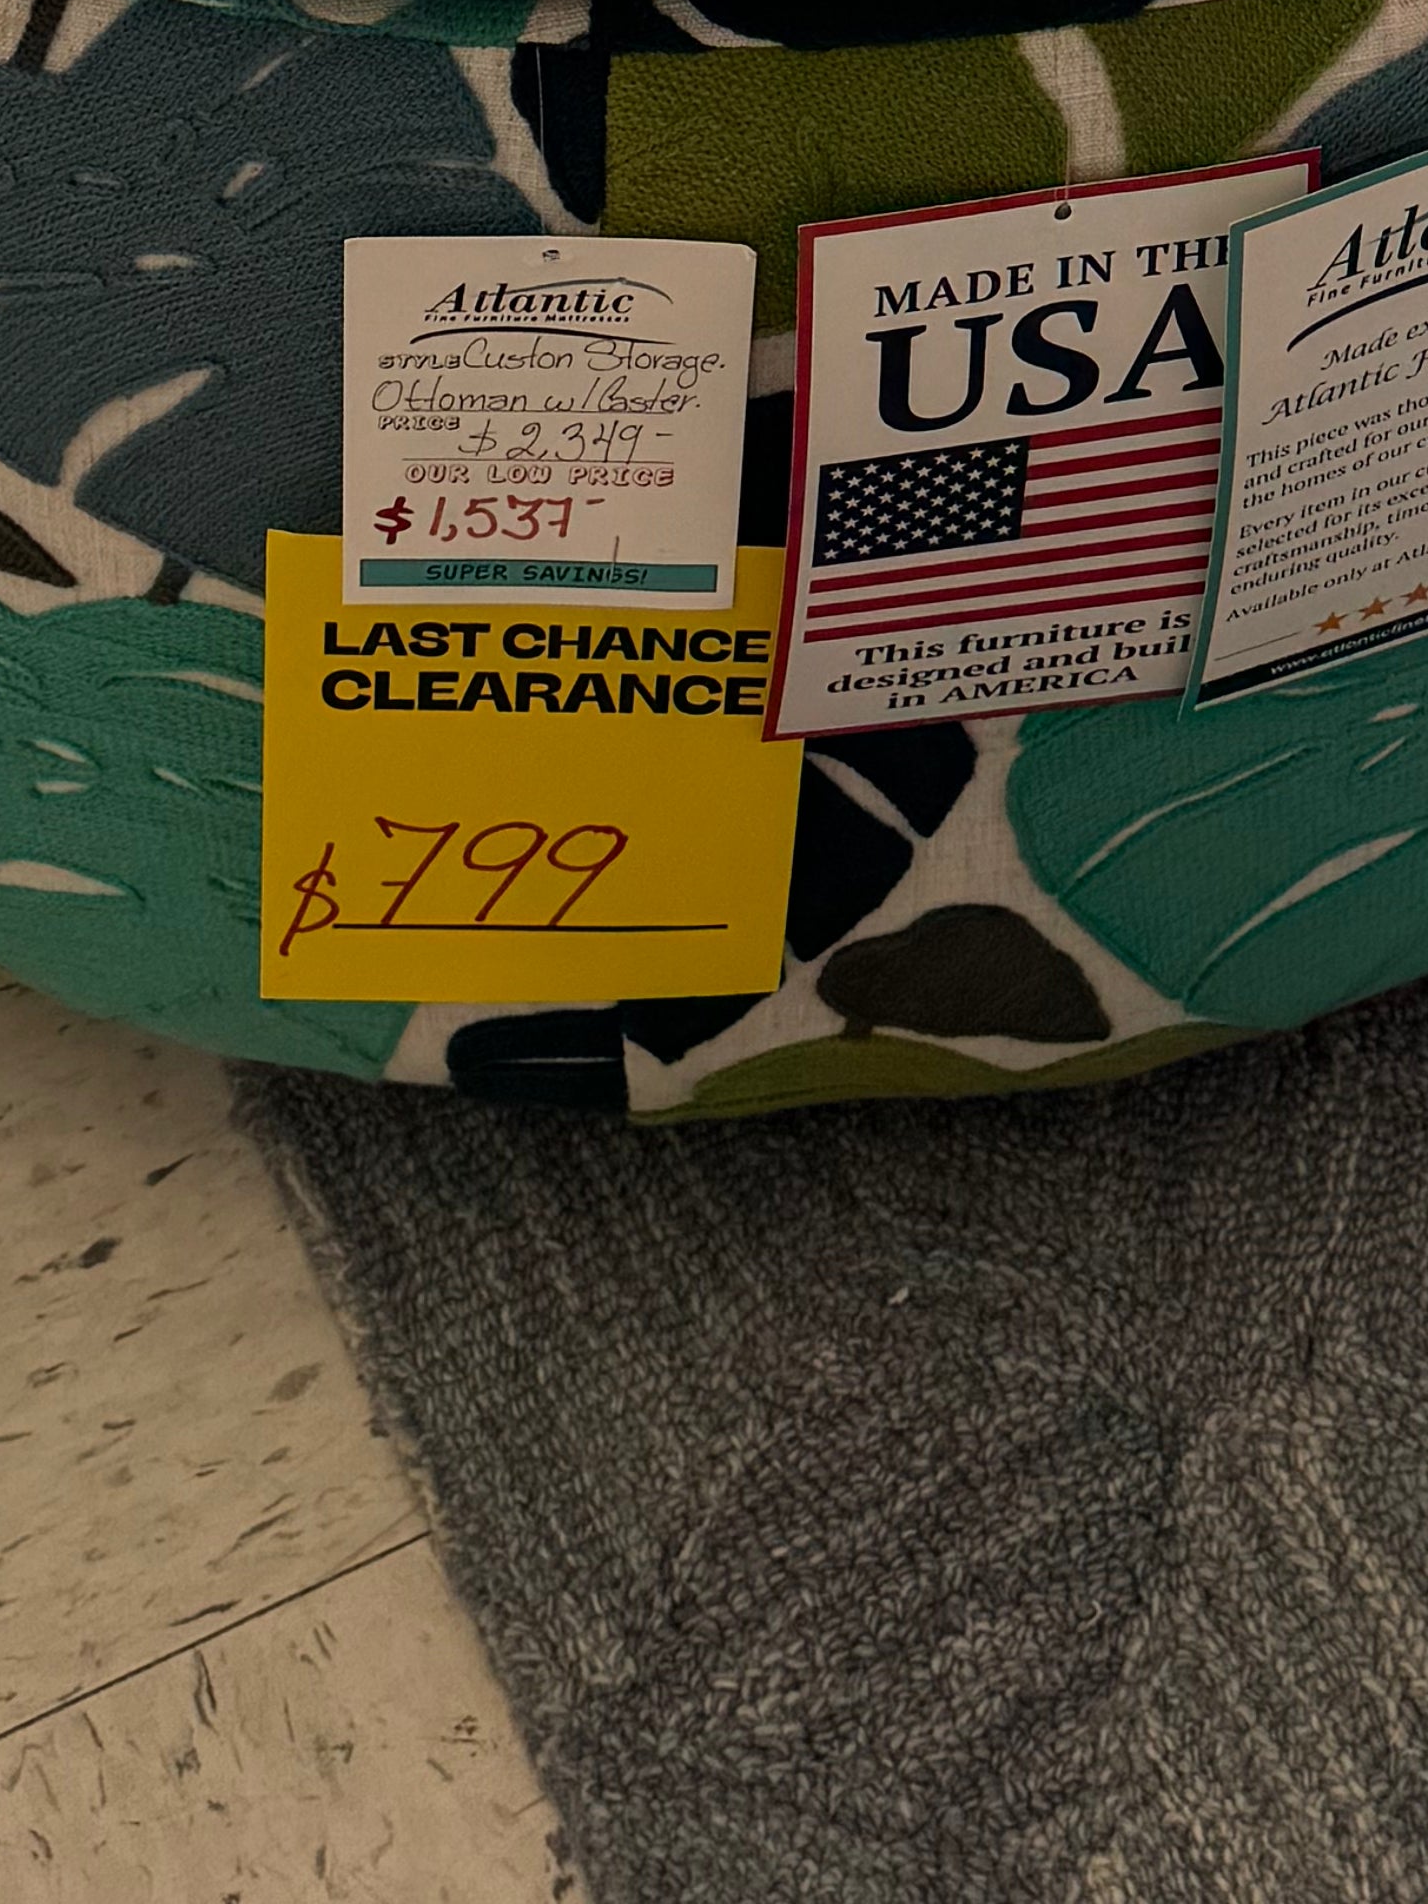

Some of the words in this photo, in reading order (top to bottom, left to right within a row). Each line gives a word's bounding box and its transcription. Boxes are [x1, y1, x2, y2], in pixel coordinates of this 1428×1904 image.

[424, 282, 634, 314] Atlantic
[874, 263, 1034, 317] MADE
[1056, 250, 1116, 289] IN
[1307, 284, 1350, 307] Fine
[424, 314, 456, 323] Fine
[464, 314, 538, 323] Furniture
[545, 314, 629, 323] Mattresses
[378, 353, 461, 370] STYLE
[865, 283, 1225, 432] USA
[1320, 329, 1398, 371] Made
[372, 376, 527, 412] Ottoman
[1262, 361, 1400, 425] Atlantic
[378, 414, 460, 430] PRICE
[1247, 444, 1290, 468] This
[1296, 425, 1349, 455] piece
[1354, 409, 1391, 431] was
[404, 464, 470, 483] OUR
[487, 465, 552, 484] LOW
[572, 465, 674, 486] PRICE
[1242, 490, 1275, 509] the
[1281, 465, 1346, 497] homes
[1352, 452, 1376, 472] of
[1378, 441, 1412, 463] our
[1244, 465, 1281, 489] and
[1288, 438, 1357, 475] crafted
[1364, 429, 1392, 449] for
[1236, 519, 1317, 558] selected
[1324, 510, 1352, 529] for
[1357, 500, 1381, 517] its
[1239, 512, 1295, 540] Every
[1300, 495, 1345, 518] item
[1352, 486, 1371, 502] in
[1376, 472, 1411, 491] our
[426, 564, 508, 581] SUPER
[521, 563, 648, 583] SAVINGS!
[1230, 556, 1321, 595] enduring
[1326, 532, 1400, 564] quality.
[1233, 521, 1379, 577] craftsmanship,
[1226, 584, 1319, 622] Available
[1323, 566, 1367, 589] only
[1372, 558, 1390, 573] at
[324, 622, 490, 657] LAST
[502, 624, 770, 663] CHANCE
[827, 655, 1012, 693] designed
[1023, 646, 1099, 672] and
[1113, 634, 1194, 660] buil
[855, 640, 945, 667] This
[958, 618, 1146, 655] furniture
[1159, 610, 1191, 631] is
[321, 669, 767, 715] CLEARANCE
[887, 692, 935, 710] in
[940, 666, 1139, 704] AMERICA
